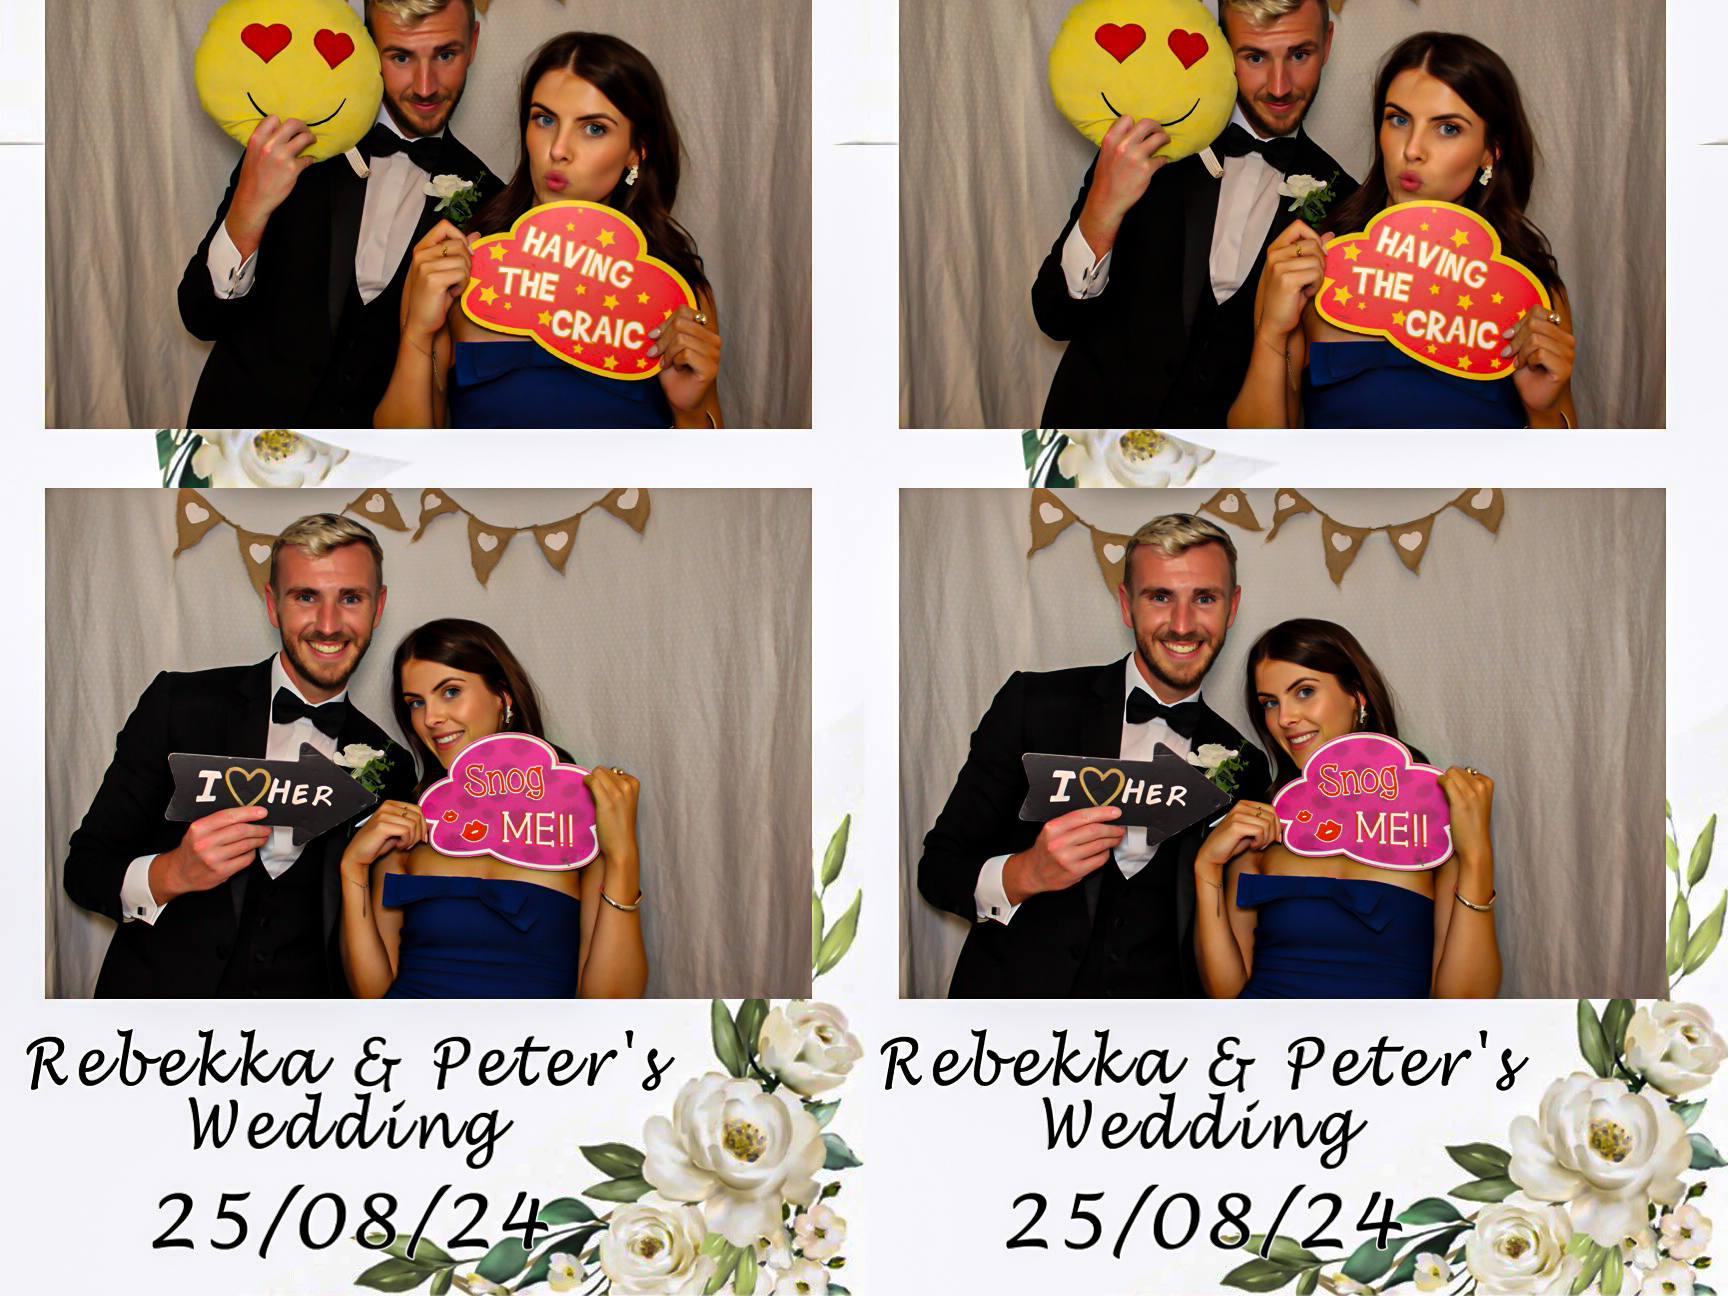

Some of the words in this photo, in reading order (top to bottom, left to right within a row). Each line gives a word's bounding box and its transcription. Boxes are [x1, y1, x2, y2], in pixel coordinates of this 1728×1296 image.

[521, 225, 635, 289] HAVING
[1375, 225, 1489, 289] HAVING
[498, 266, 560, 303] THE
[1352, 266, 1414, 303] THE
[551, 309, 646, 350] CRAIC
[1405, 309, 1500, 350] CRAIC
[195, 770, 222, 803] I
[267, 777, 334, 807] HER
[464, 763, 545, 801] Snog
[1049, 770, 1076, 803] I
[1121, 777, 1188, 807] HER
[1318, 763, 1399, 801] Snog
[501, 811, 574, 848] ME!!
[1355, 811, 1428, 848] ME!!
